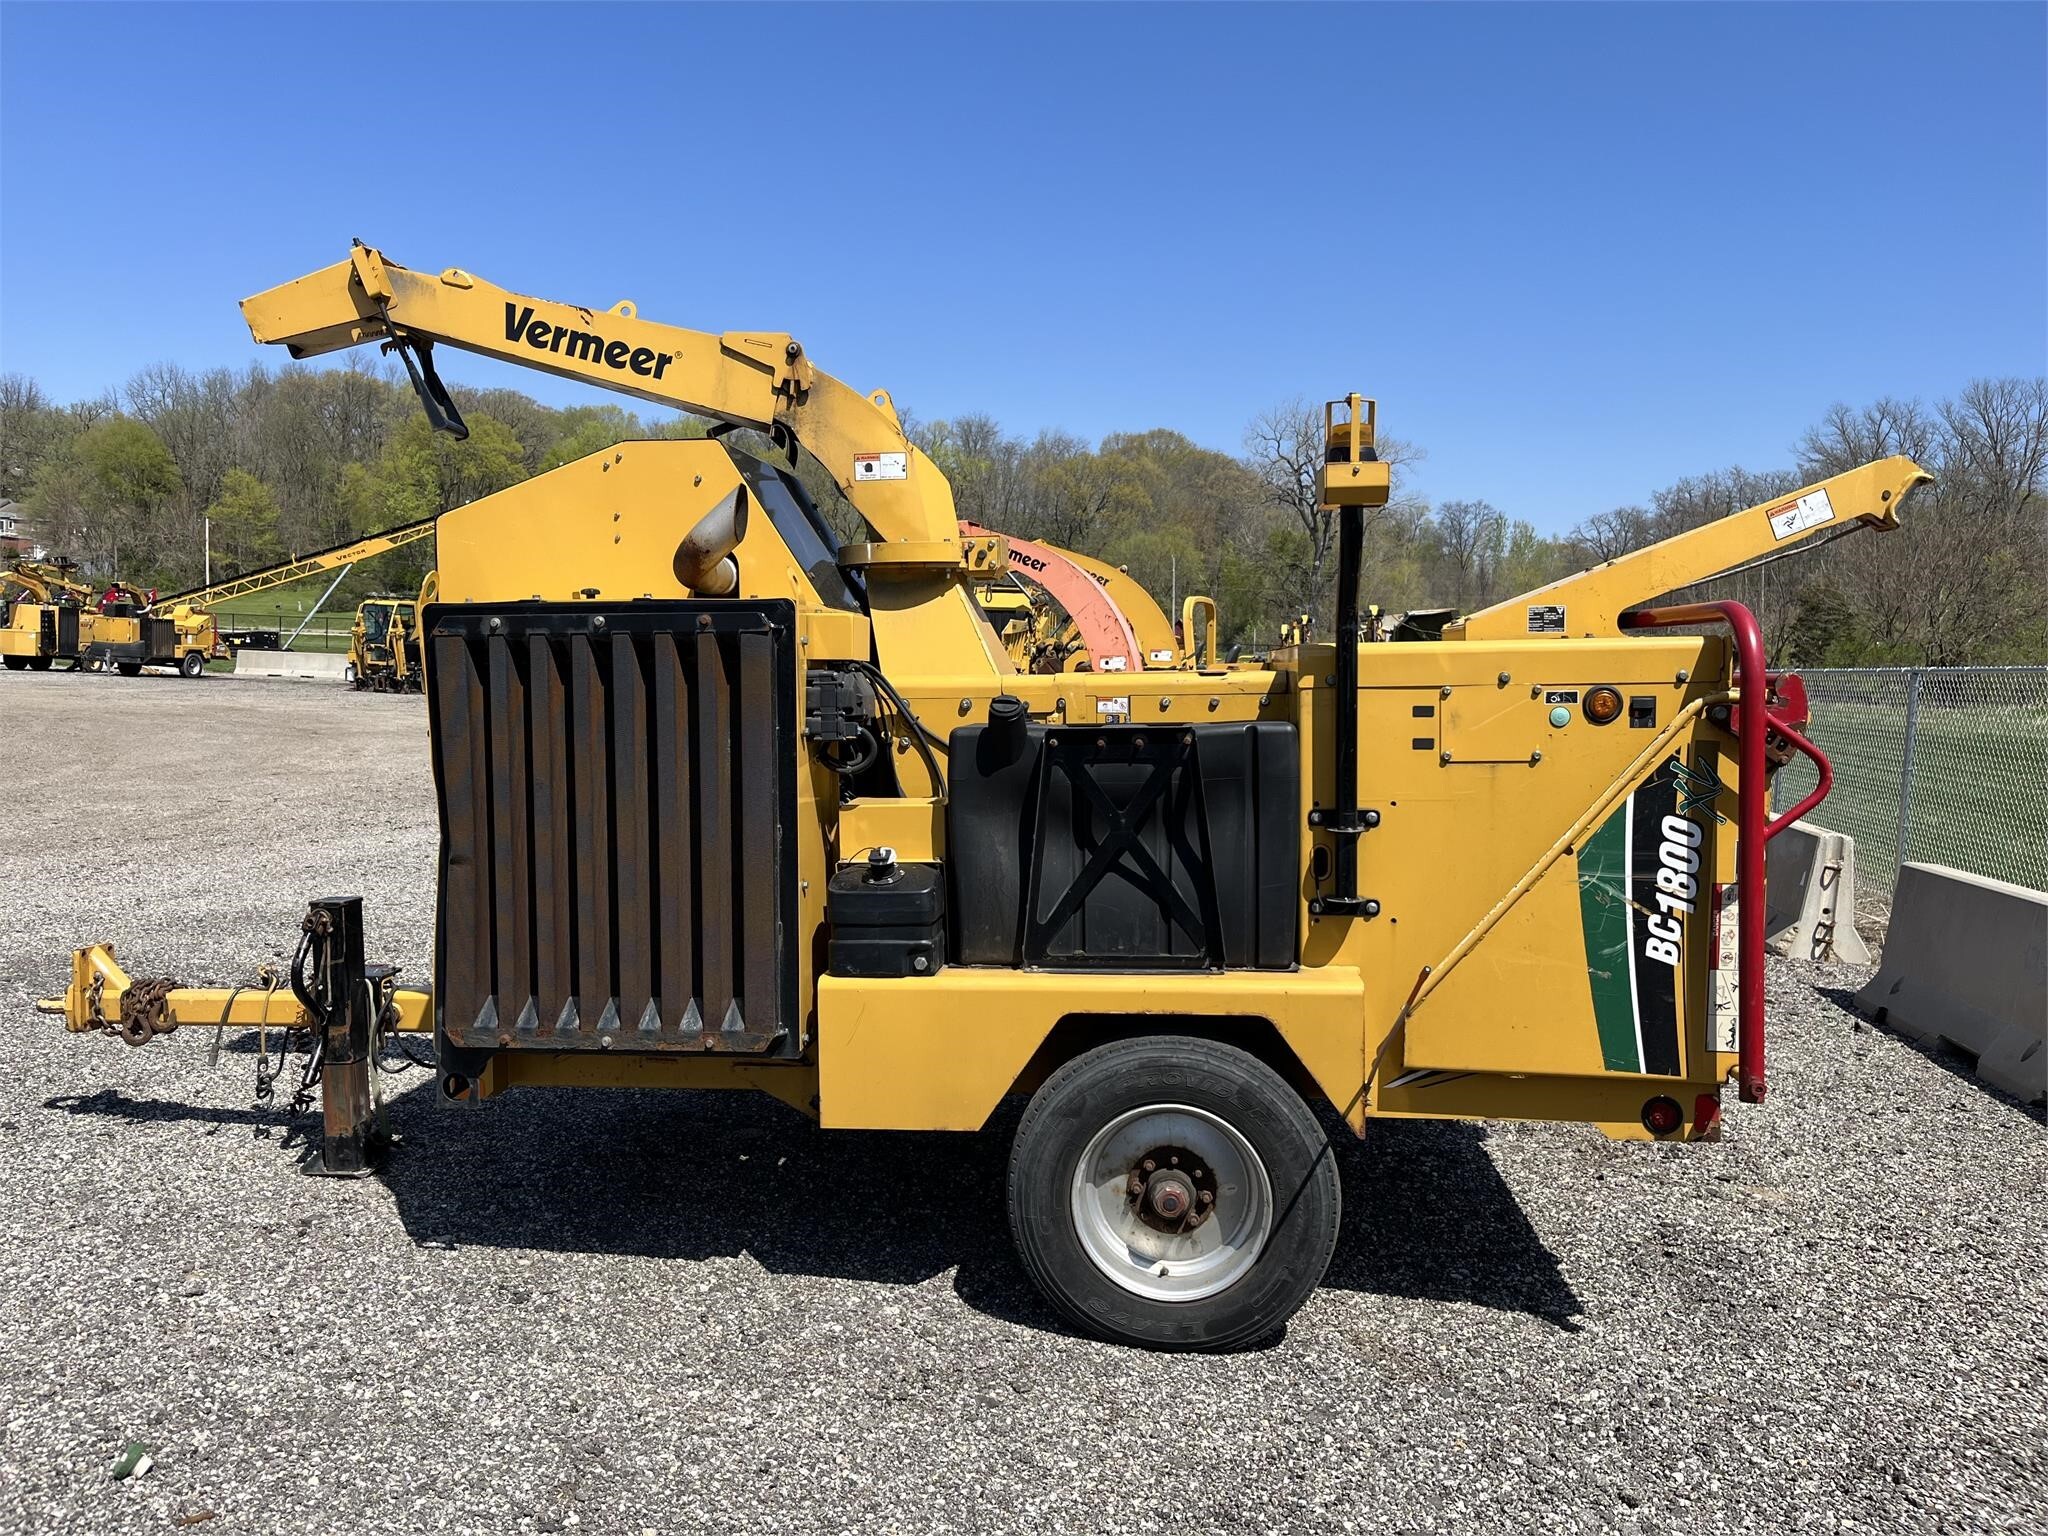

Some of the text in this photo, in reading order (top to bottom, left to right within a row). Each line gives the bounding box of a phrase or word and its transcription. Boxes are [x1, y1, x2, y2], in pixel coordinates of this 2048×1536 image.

[505, 301, 673, 380] Vermeer
[1009, 549, 1047, 573] meer
[1645, 755, 1727, 966] BC1800 XL
